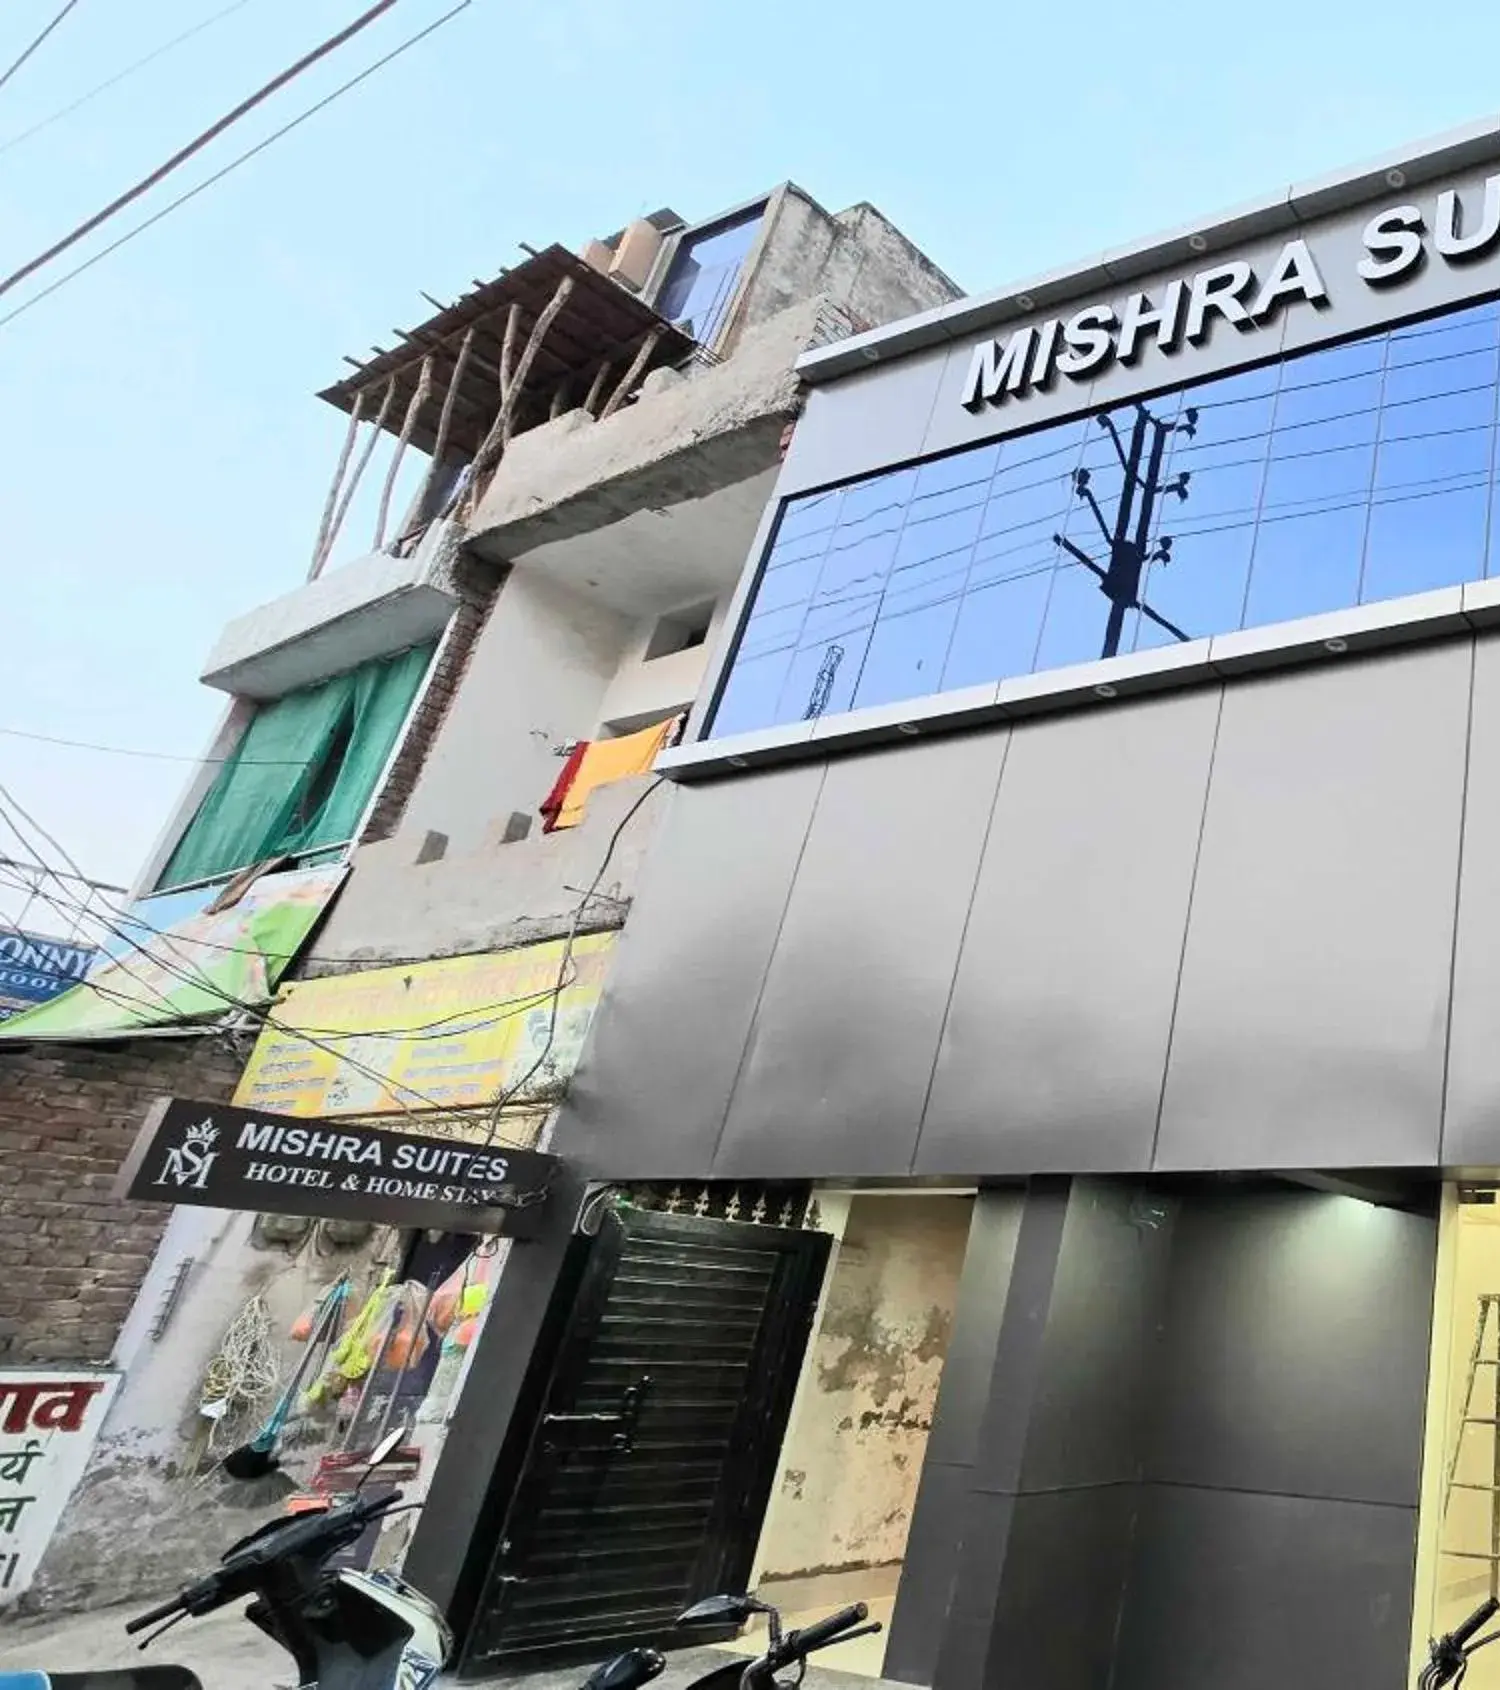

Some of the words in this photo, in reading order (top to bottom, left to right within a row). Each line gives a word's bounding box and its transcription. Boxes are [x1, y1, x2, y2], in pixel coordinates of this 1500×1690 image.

[958, 238, 1331, 414] MISHRA
[236, 1122, 383, 1166] MISHRA
[391, 1144, 510, 1182] SUITES
[243, 1161, 336, 1190] HOTEL
[340, 1174, 359, 1192] &
[364, 1178, 438, 1201] HOME
